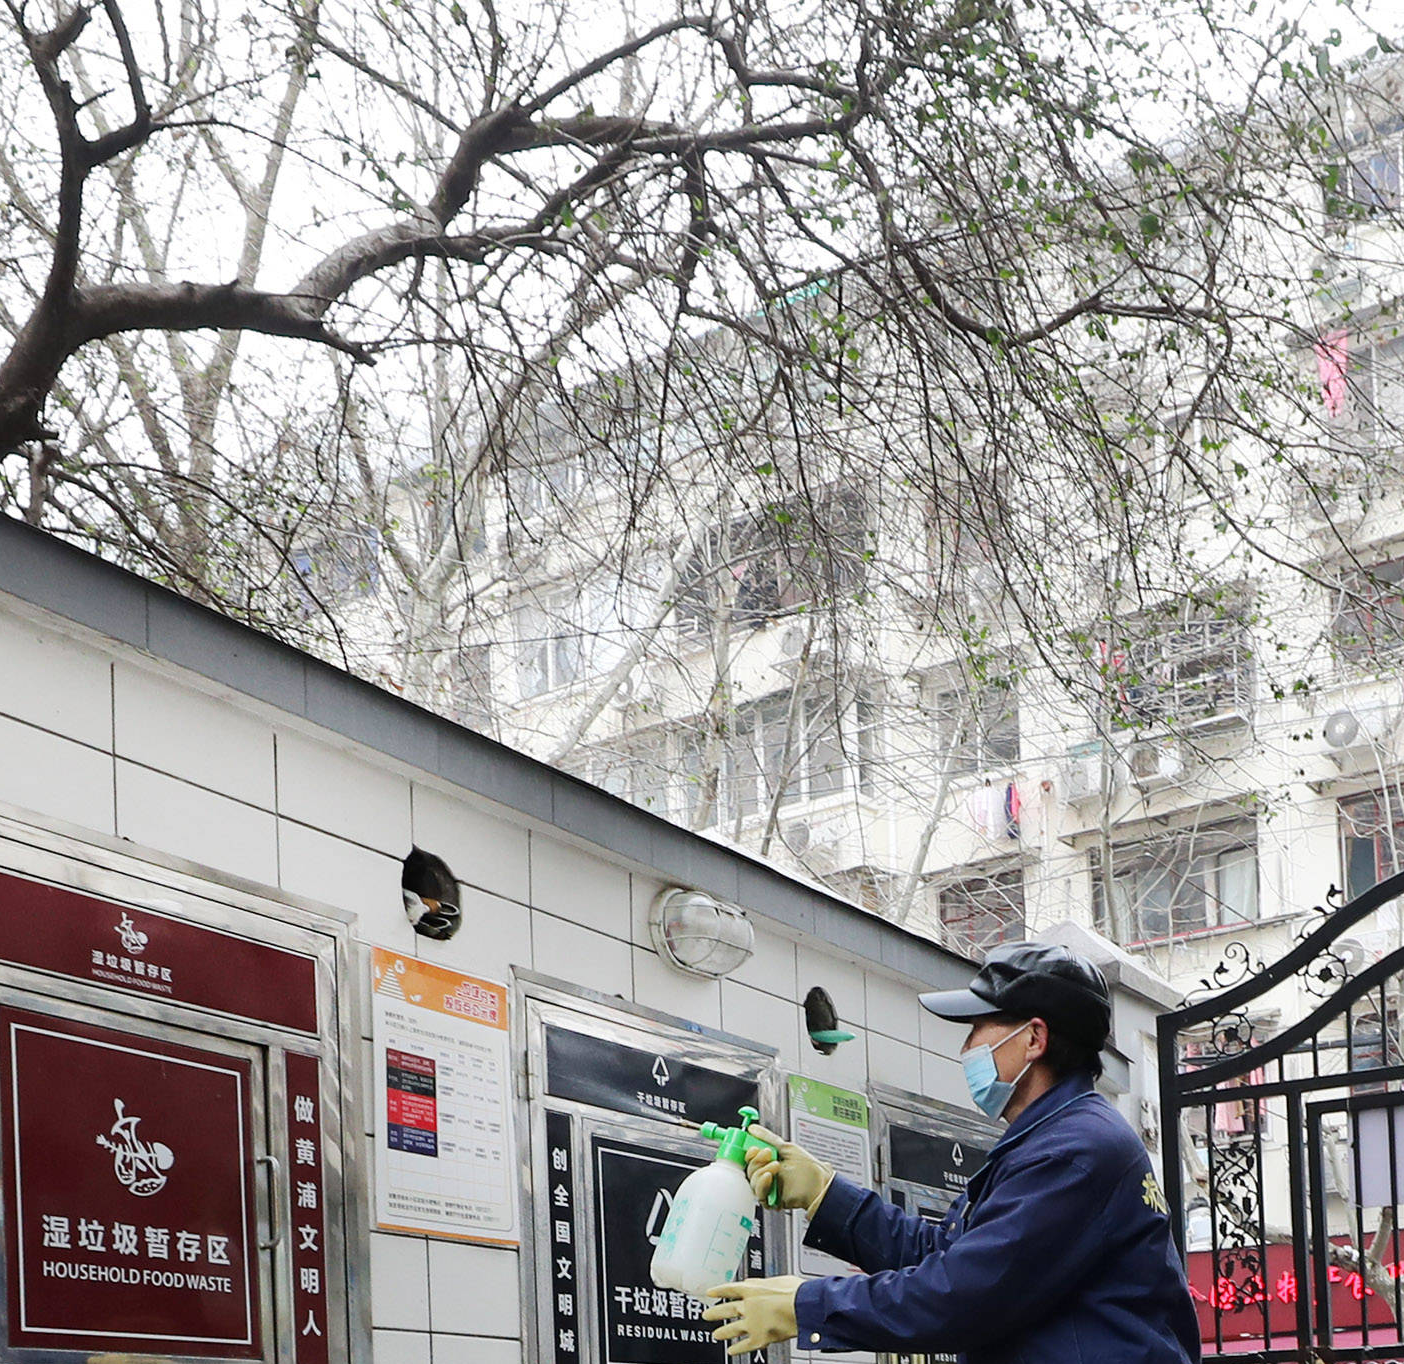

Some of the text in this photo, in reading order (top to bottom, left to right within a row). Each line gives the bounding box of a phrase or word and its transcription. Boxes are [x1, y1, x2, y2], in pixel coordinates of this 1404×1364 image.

[91, 949, 173, 983] 湿垃圾暂存区
[293, 1095, 322, 1338] 做黄浦文明人
[42, 1214, 232, 1266] 湿垃圾暂存区
[551, 1147, 576, 1353] 创全国文明城
[42, 1260, 233, 1293] HOUSEHOLD FOOD WASTE
[614, 1286, 709, 1320] 干垃圾暂存
[616, 1323, 678, 1342] RESIDUAL
